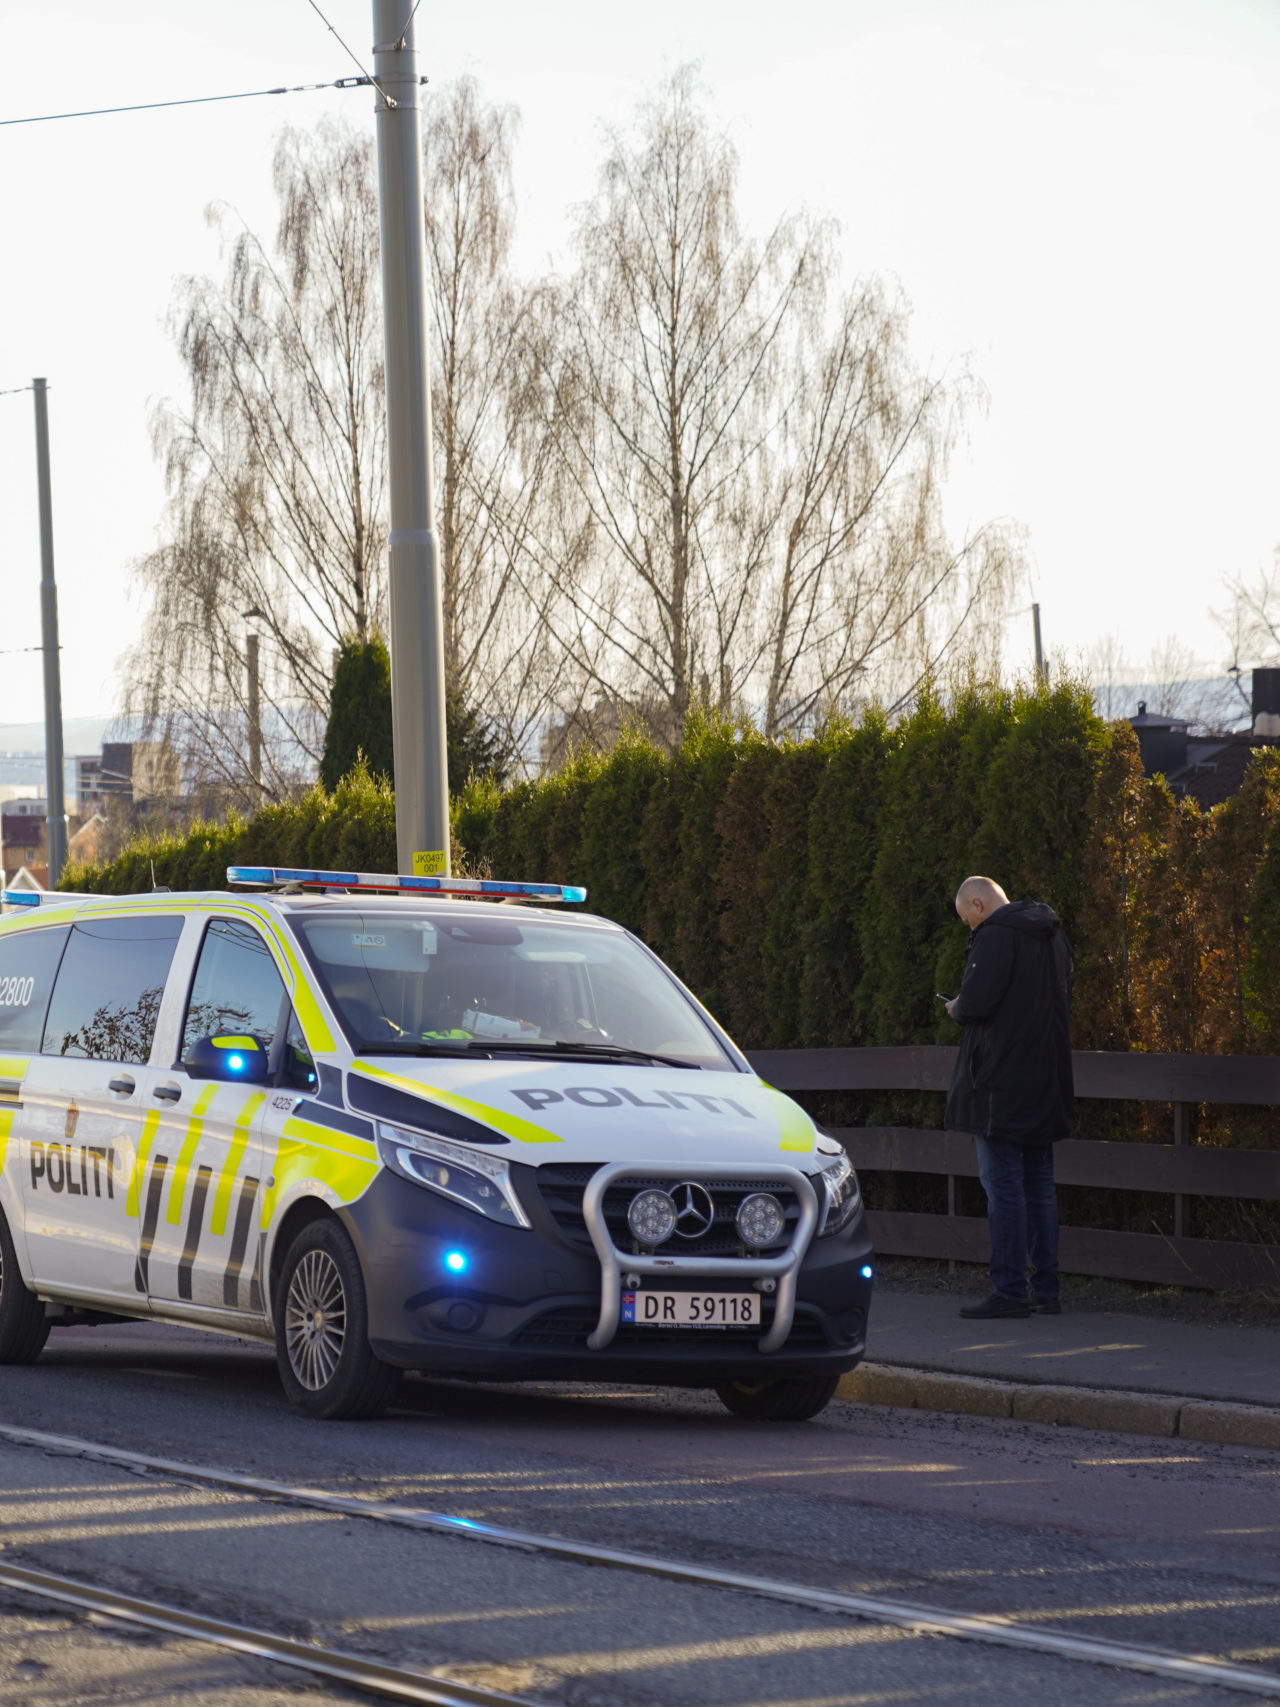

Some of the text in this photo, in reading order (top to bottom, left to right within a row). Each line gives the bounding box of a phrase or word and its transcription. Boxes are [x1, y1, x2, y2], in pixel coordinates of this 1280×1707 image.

[424, 864, 438, 873] 001
[272, 1096, 293, 1111] 4225
[510, 1086, 757, 1119] POLITI
[30, 1141, 115, 1199] POLITI
[624, 1310, 632, 1319] N
[644, 1295, 753, 1322] DR 59118
